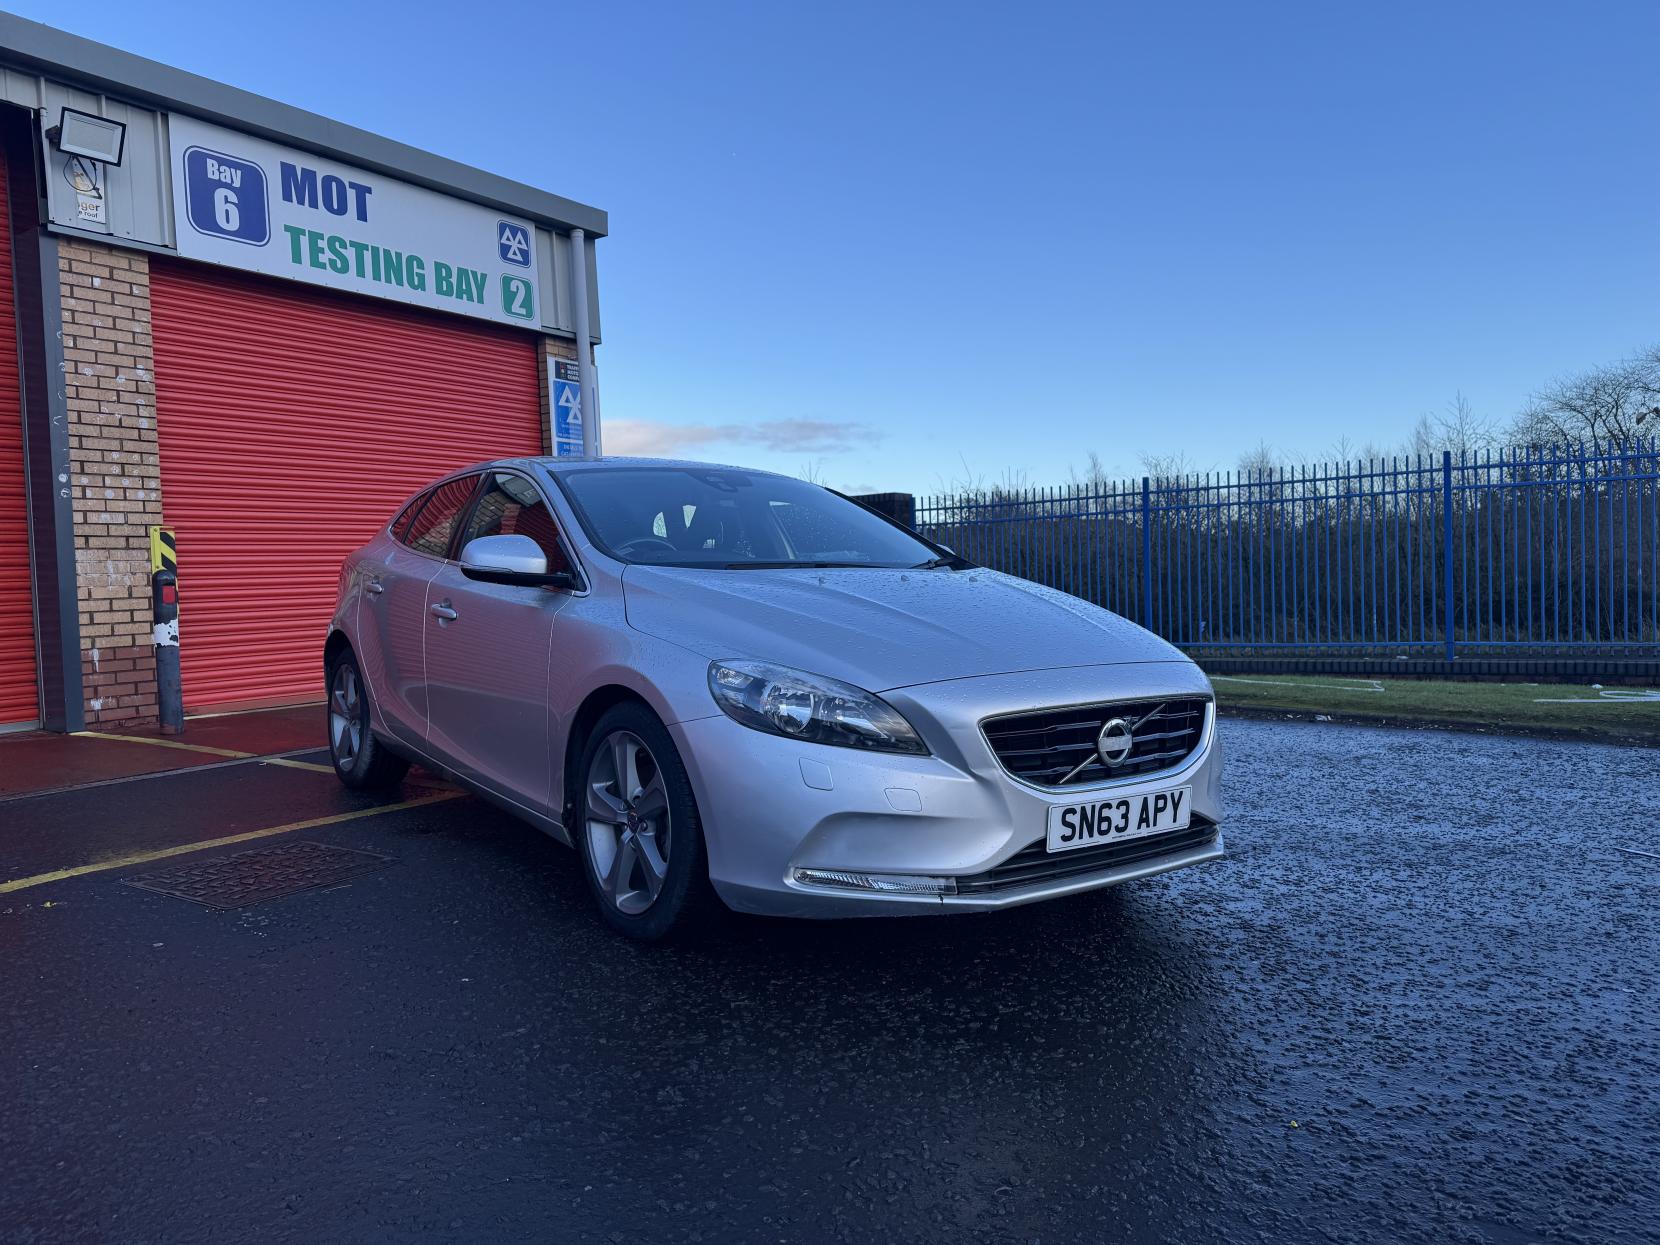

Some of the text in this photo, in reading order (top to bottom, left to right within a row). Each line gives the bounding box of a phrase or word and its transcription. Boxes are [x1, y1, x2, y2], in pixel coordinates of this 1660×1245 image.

[206, 158, 241, 188] Bay
[279, 161, 372, 222] MOT
[78, 202, 100, 211] ger
[214, 188, 240, 231] 6
[283, 224, 488, 304] TESTING BAY
[510, 279, 527, 315] 2
[1060, 791, 1183, 842] SN63 APY
